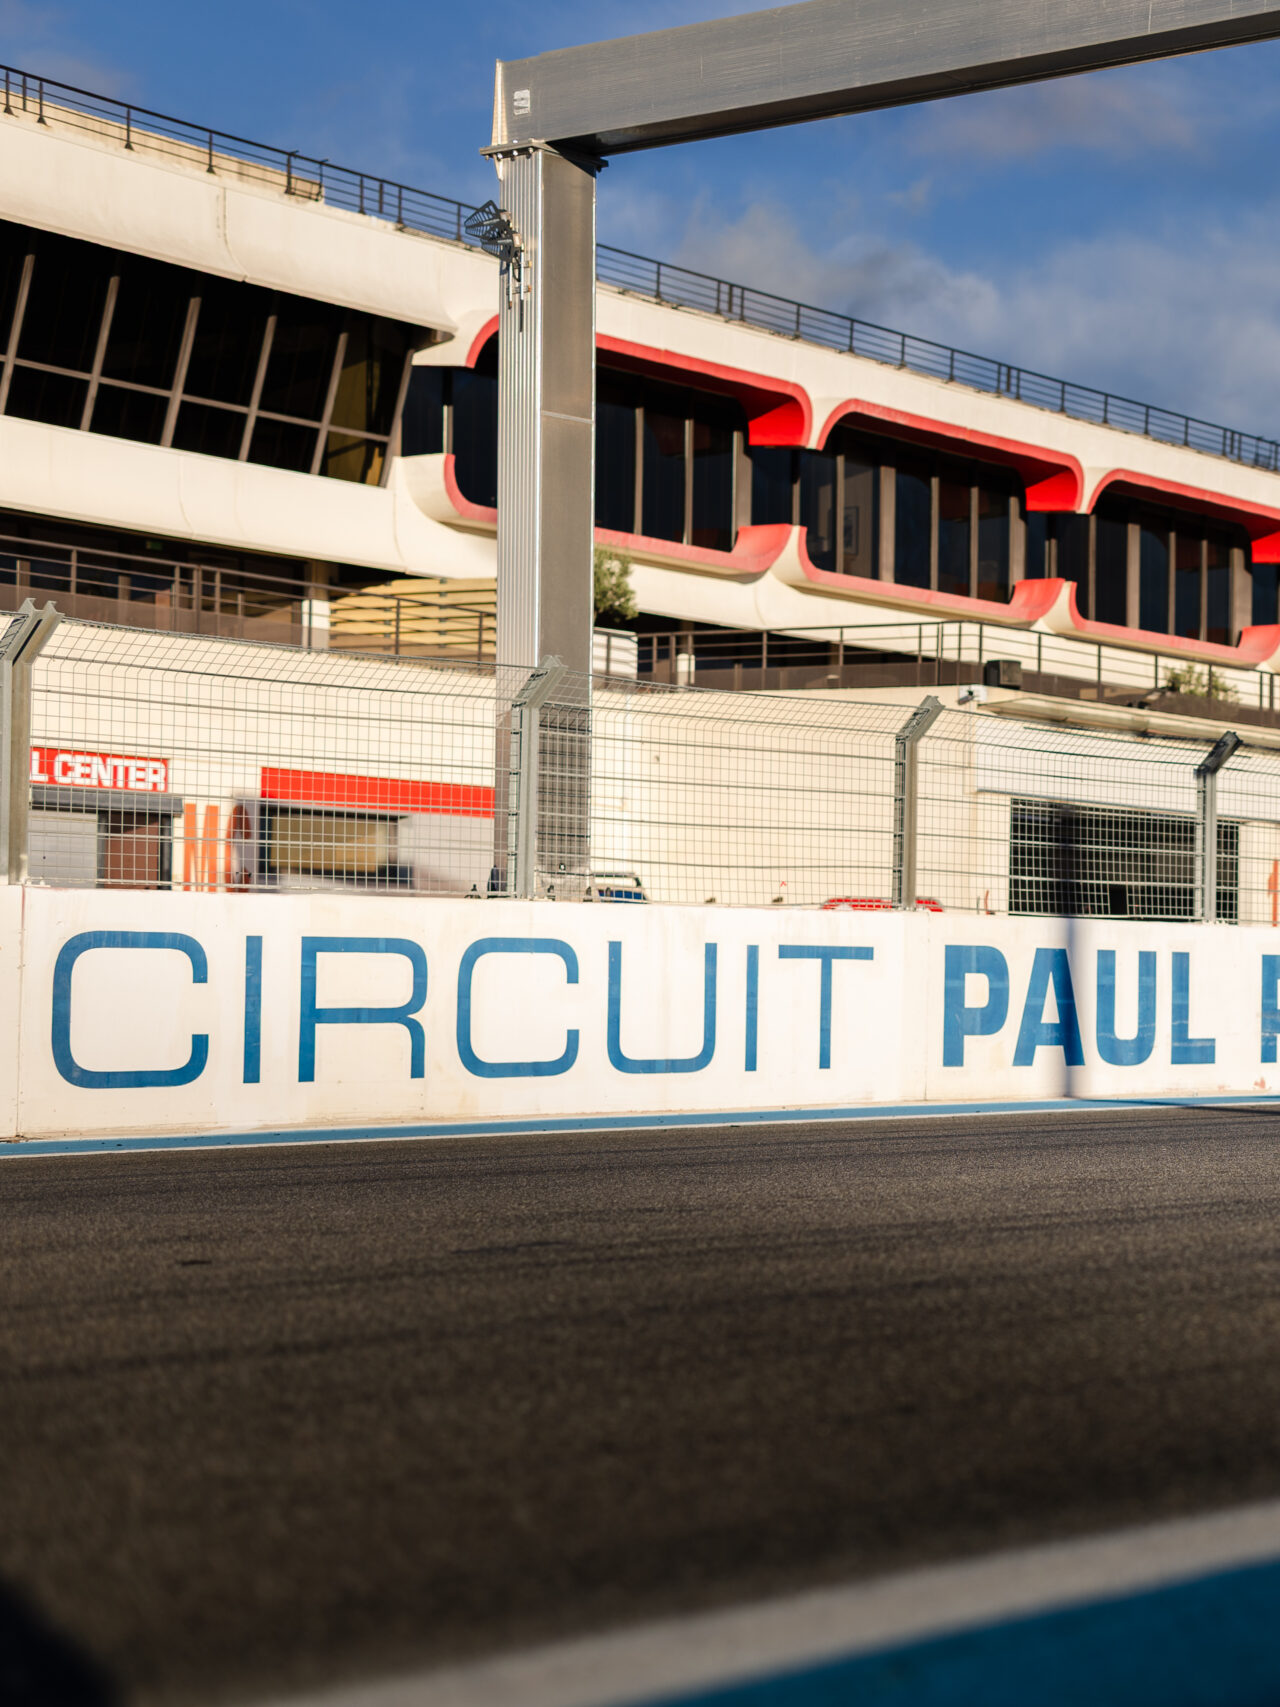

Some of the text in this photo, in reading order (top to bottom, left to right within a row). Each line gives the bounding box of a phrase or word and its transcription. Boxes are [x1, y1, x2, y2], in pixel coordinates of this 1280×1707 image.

[54, 753, 167, 791] CENTER
[52, 931, 875, 1088] CIRCUIT
[943, 945, 1216, 1066] PAUL
